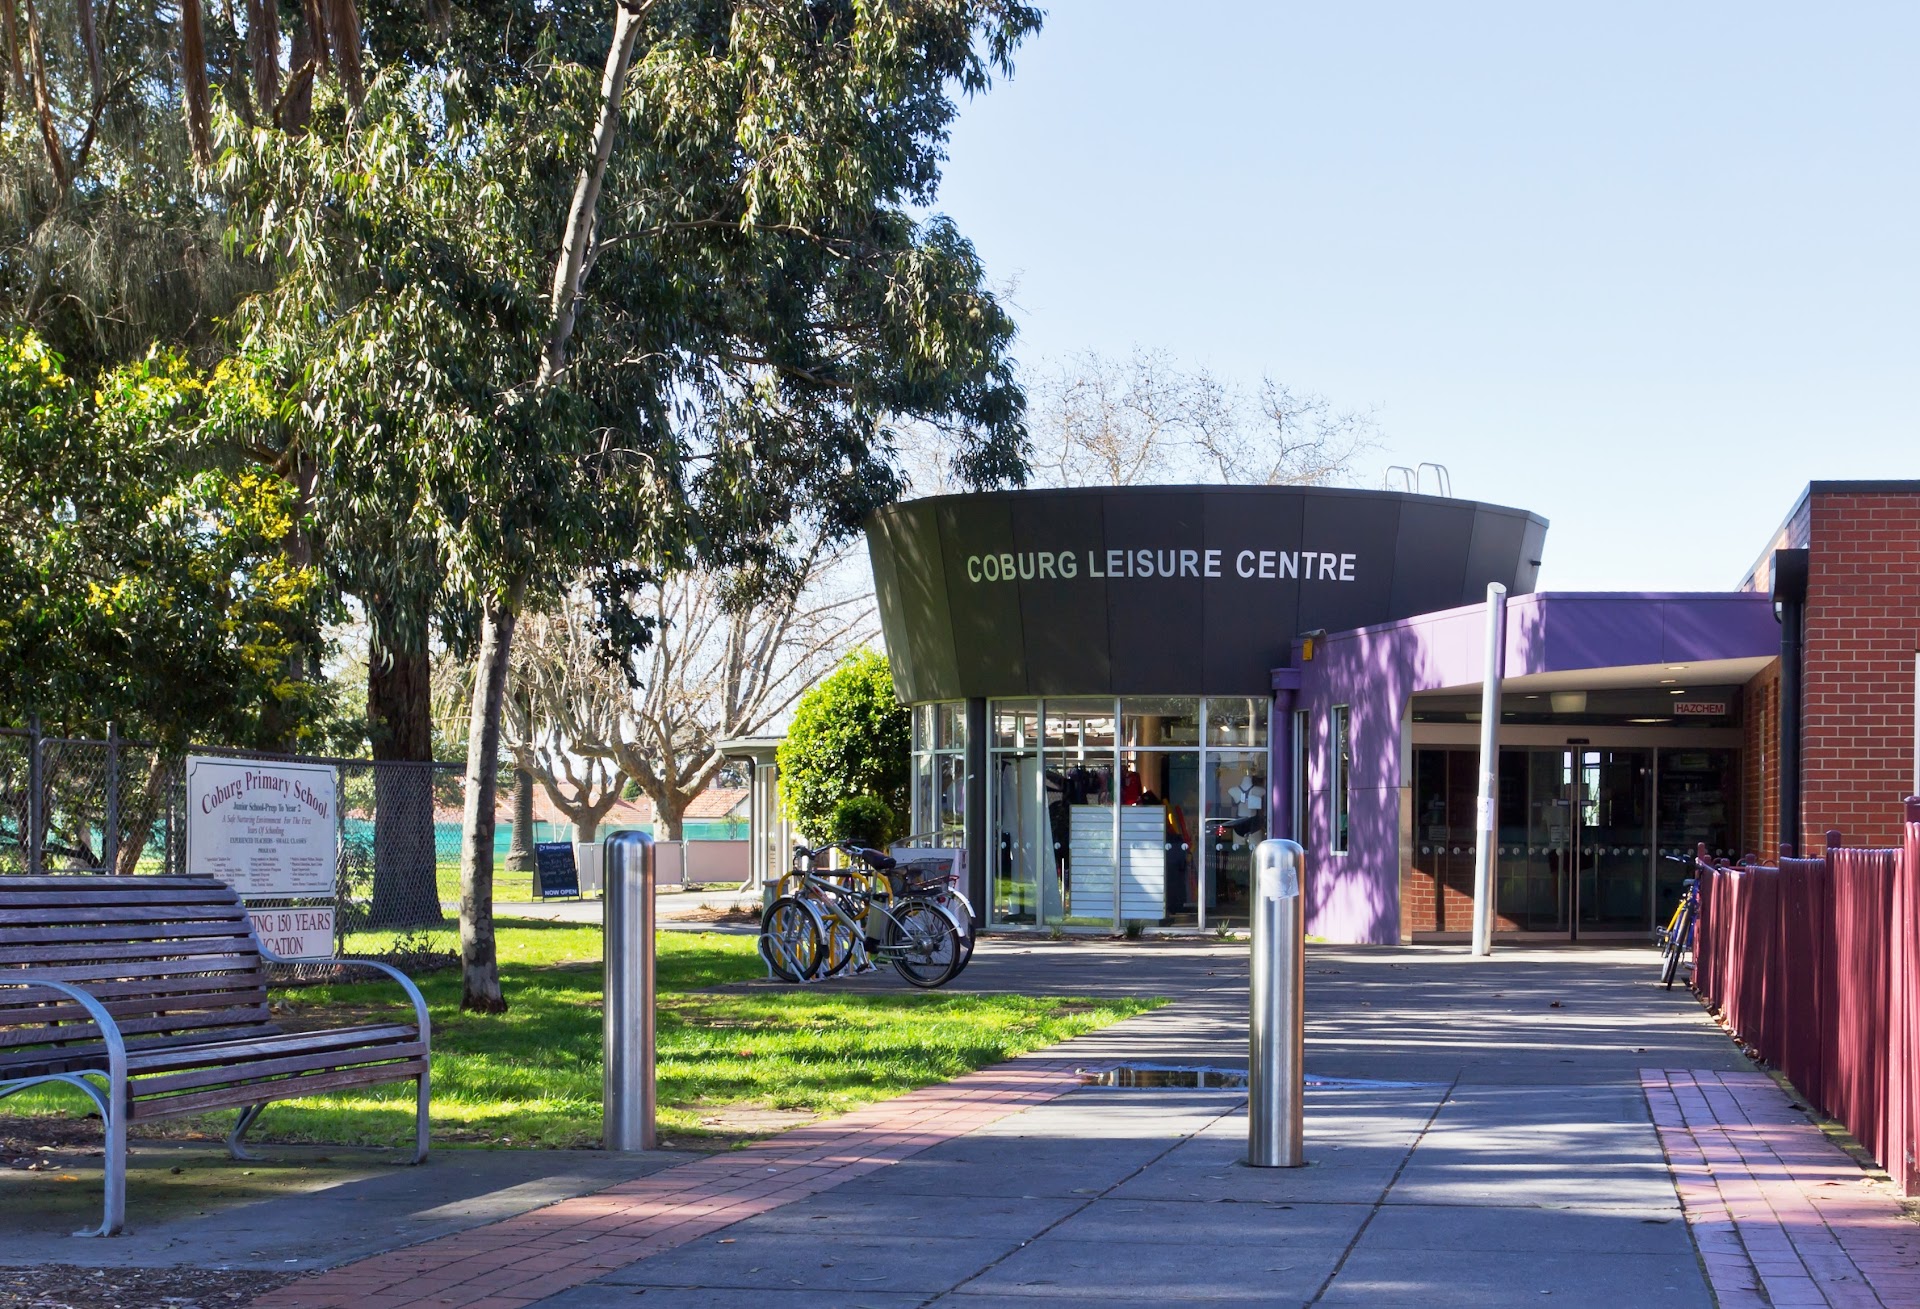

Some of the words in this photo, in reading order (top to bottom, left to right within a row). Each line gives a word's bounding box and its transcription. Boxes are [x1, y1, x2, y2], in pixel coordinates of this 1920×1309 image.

[967, 550, 1078, 583] COBURG
[1089, 549, 1222, 578] LEISURE
[1236, 549, 1357, 582] CENTRE
[1676, 703, 1724, 713] HAZCHEM
[202, 779, 243, 815] Coburg
[245, 770, 291, 799] Primary
[293, 779, 328, 819] School
[233, 802, 248, 811] Junior
[279, 803, 284, 812] To
[285, 803, 297, 812] Year
[297, 804, 301, 812] 2
[226, 815, 235, 824] Safe
[284, 816, 292, 824] For
[292, 816, 301, 825] The
[301, 816, 312, 825] First
[258, 826, 265, 836] Of
[278, 913, 291, 932] 150
[295, 913, 331, 931] YEARS
